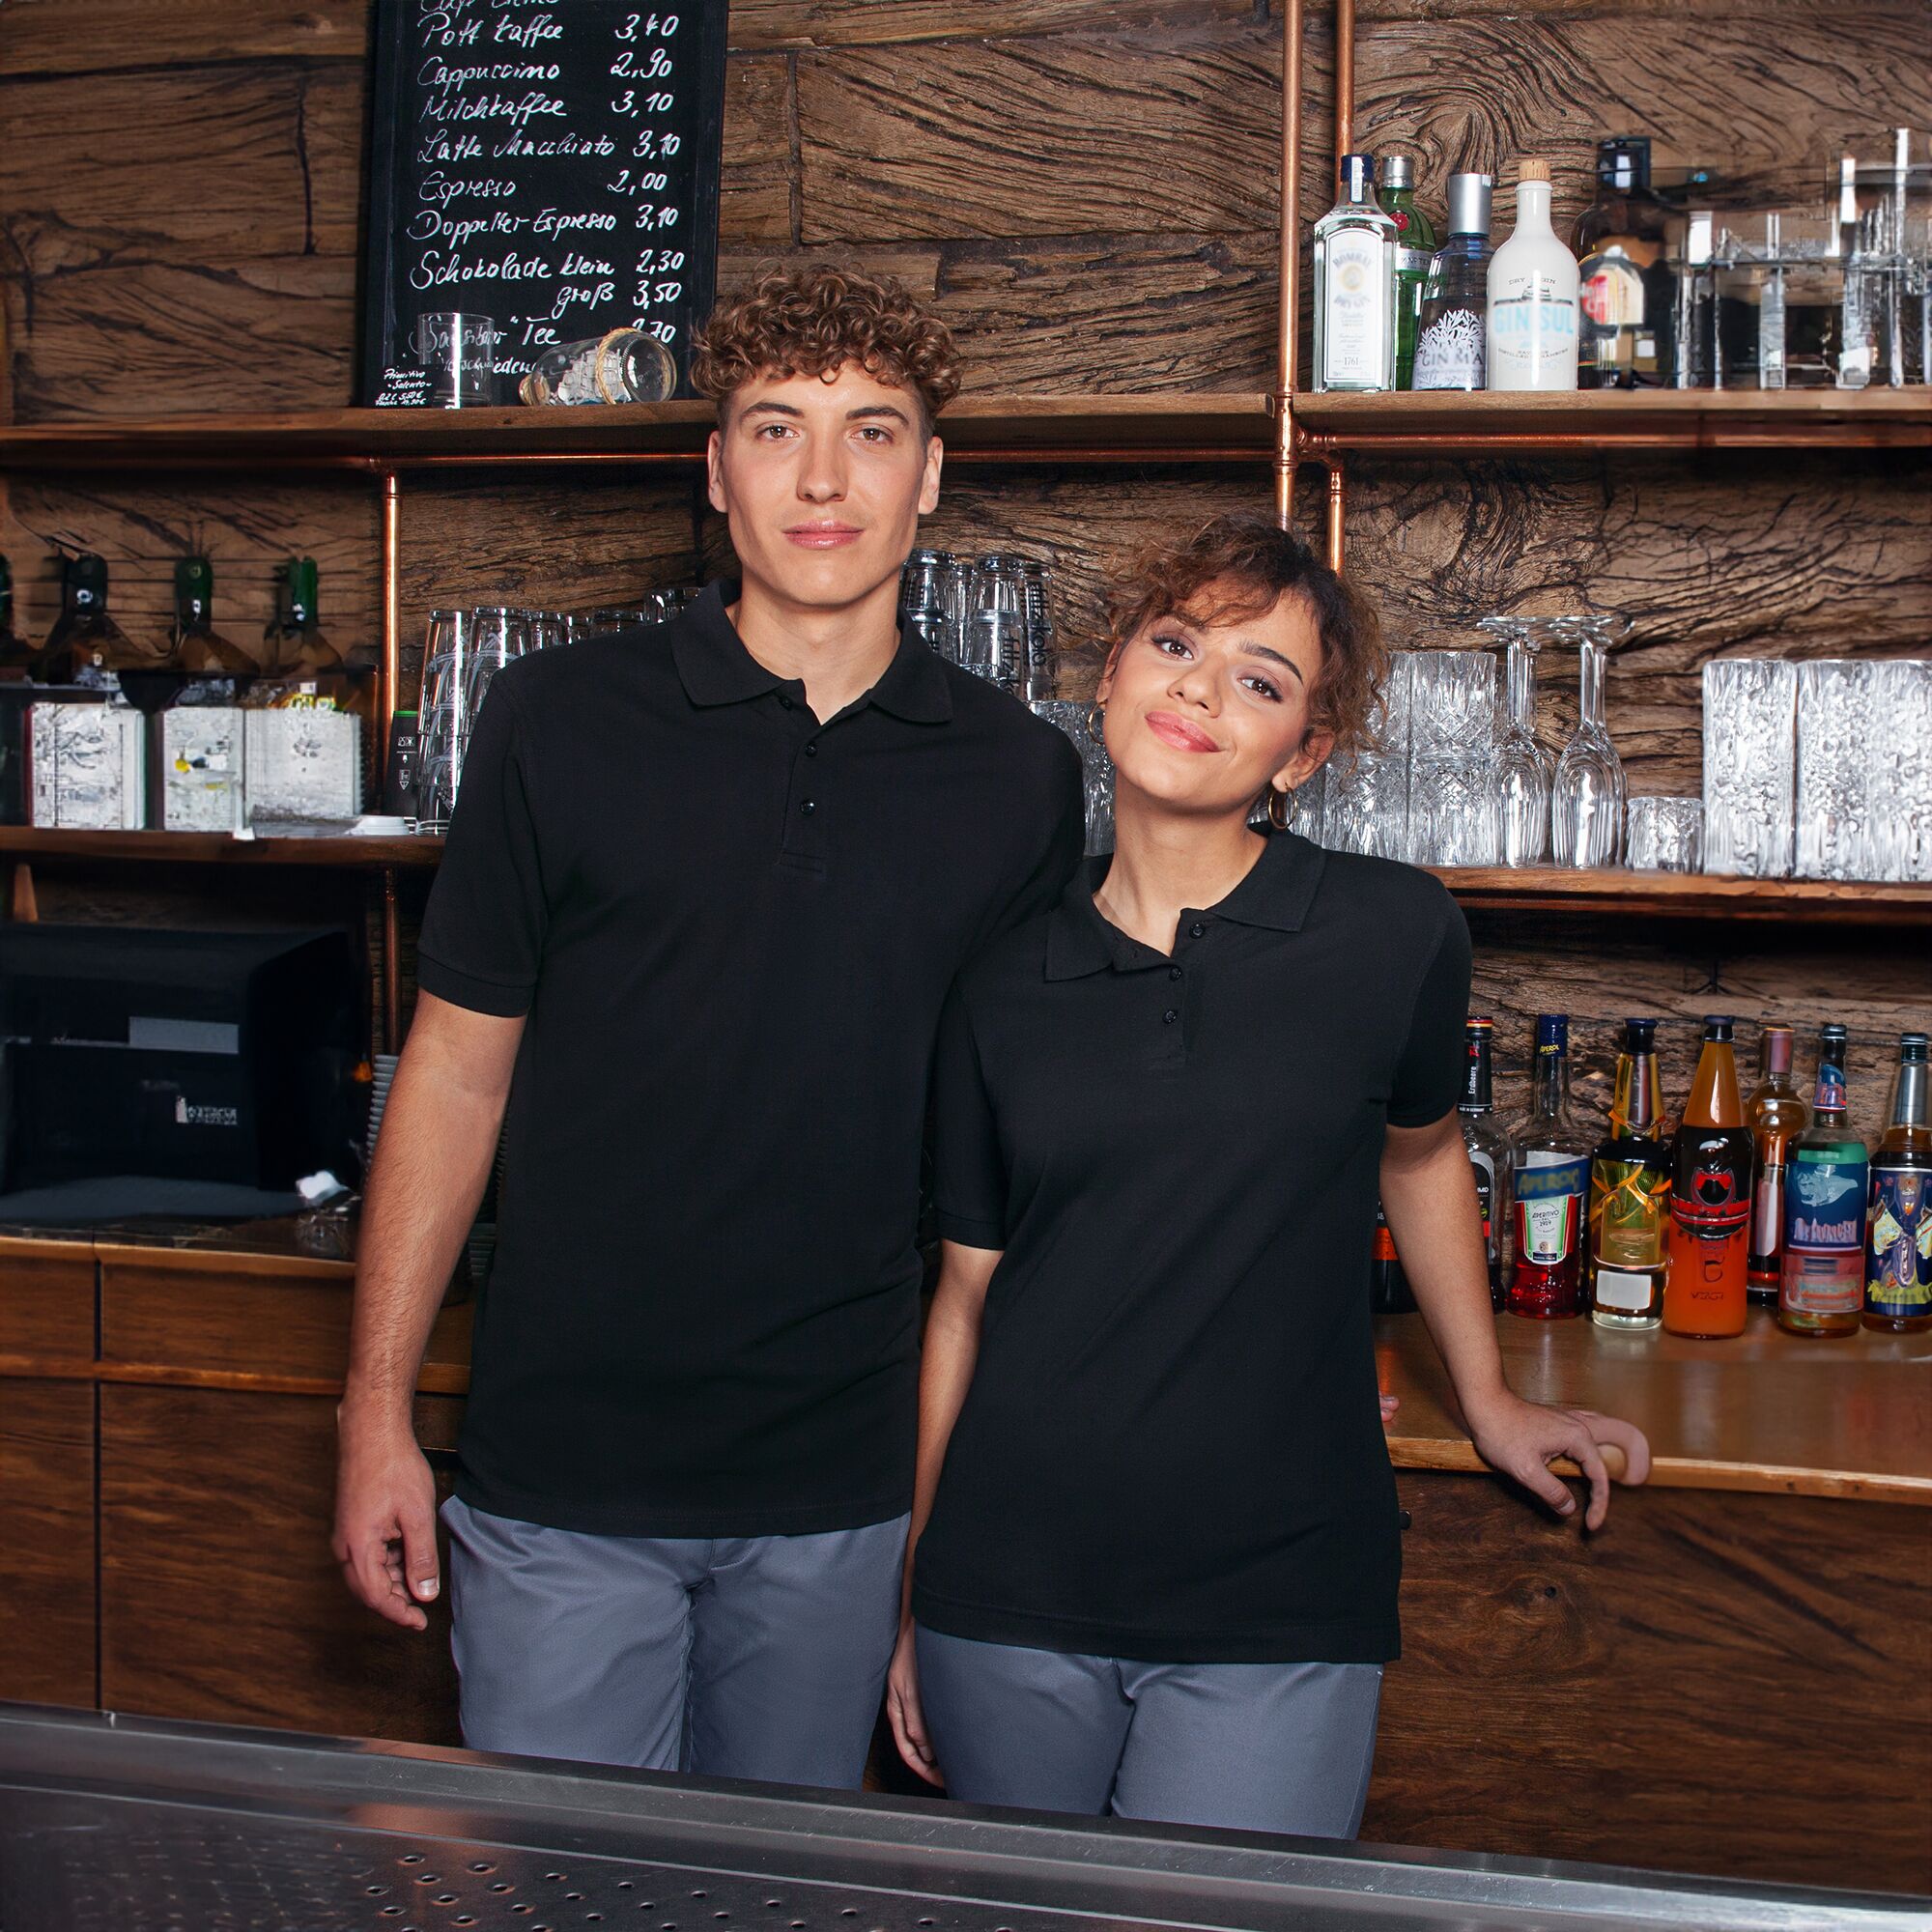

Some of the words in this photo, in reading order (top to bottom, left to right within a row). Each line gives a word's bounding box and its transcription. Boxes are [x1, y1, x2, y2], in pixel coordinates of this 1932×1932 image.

[610, 47, 673, 78] 2,90
[611, 90, 674, 118] 3,10
[418, 171, 517, 209] Espresso
[607, 169, 668, 196] 2,00
[635, 204, 679, 231] 3,10
[410, 250, 553, 290] Schokolade
[636, 248, 685, 275] 2,30
[633, 279, 683, 310] 3,50
[522, 316, 561, 345] Tee
[1540, 305, 1574, 334] SUL
